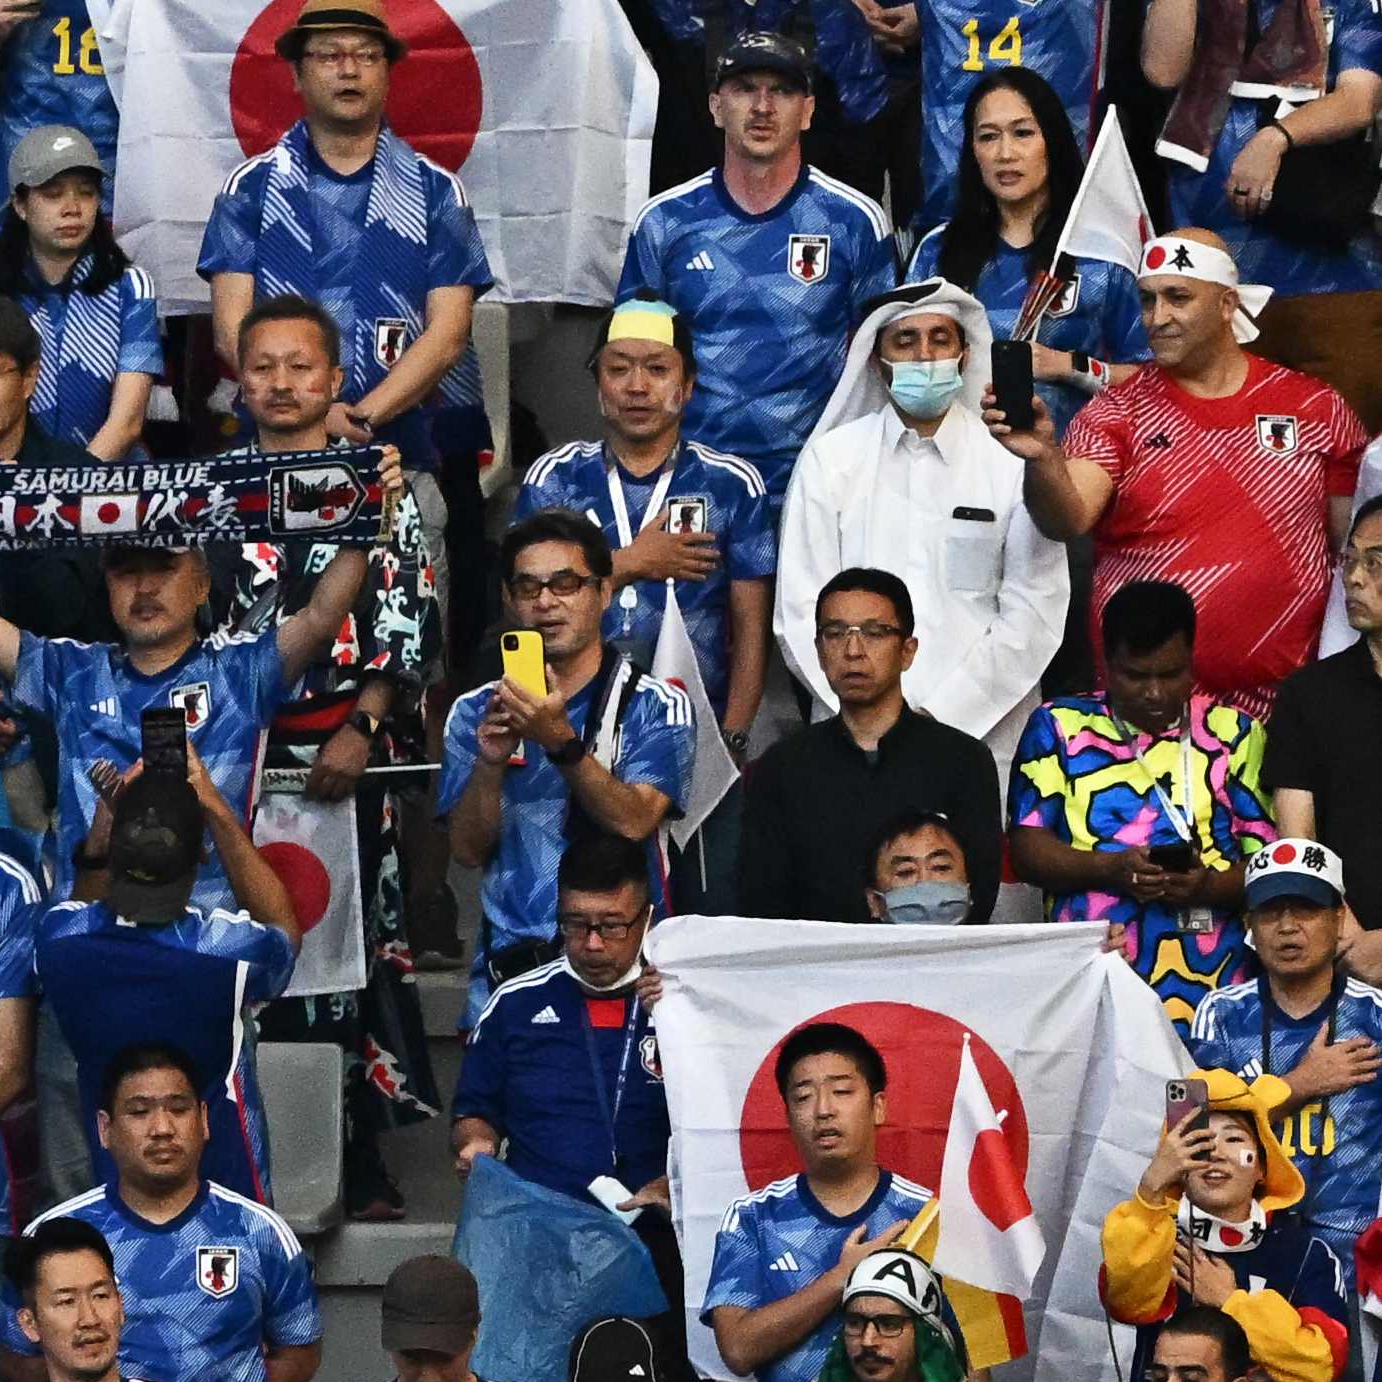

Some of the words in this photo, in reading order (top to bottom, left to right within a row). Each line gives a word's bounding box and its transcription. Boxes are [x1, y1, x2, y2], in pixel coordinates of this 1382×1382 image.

[962, 16, 1023, 71] 14
[11, 466, 138, 495] SAMURAI
[141, 463, 209, 487] BLUE
[1246, 845, 1329, 877] 必勝
